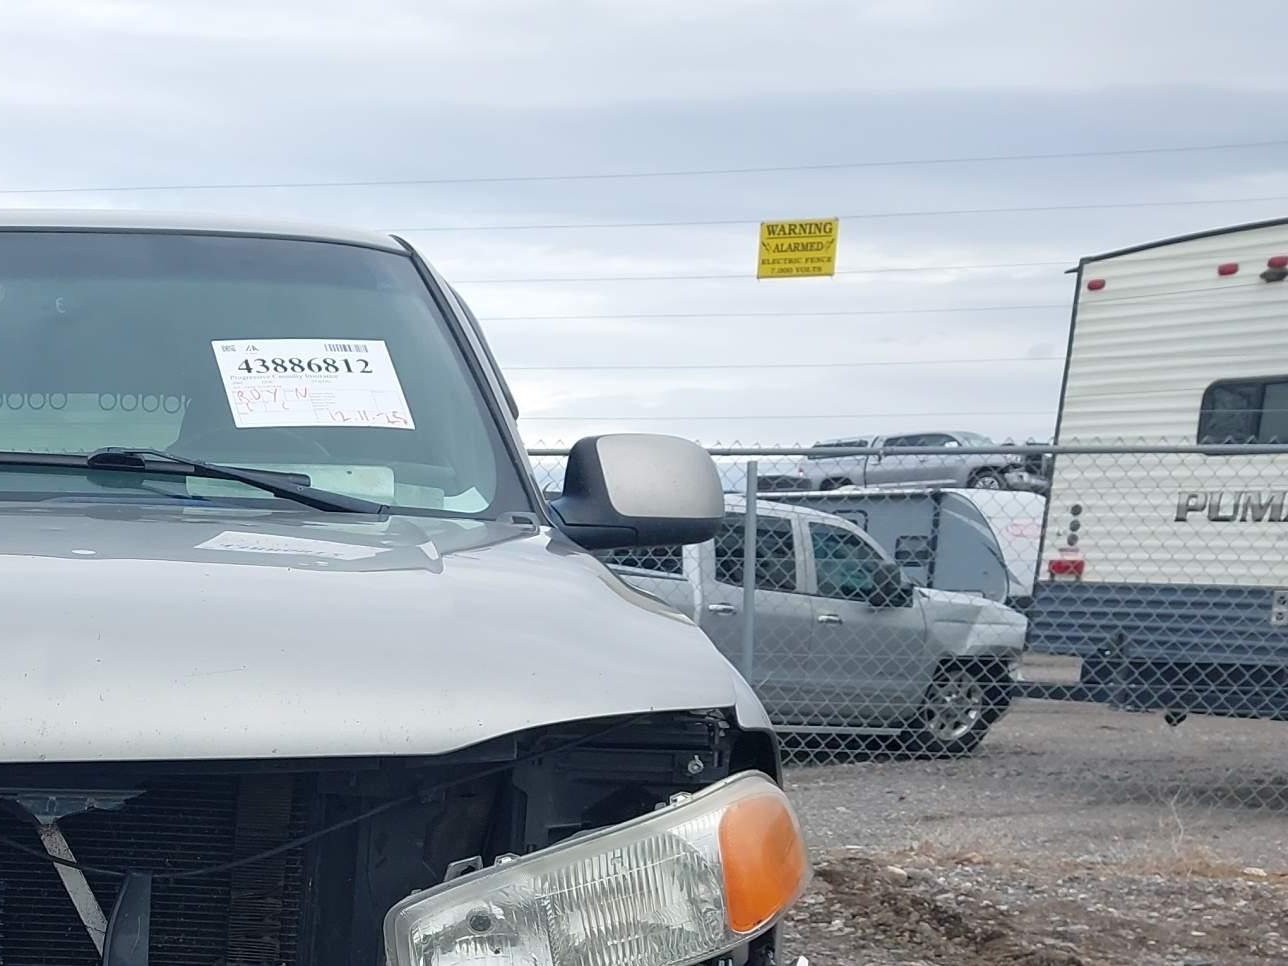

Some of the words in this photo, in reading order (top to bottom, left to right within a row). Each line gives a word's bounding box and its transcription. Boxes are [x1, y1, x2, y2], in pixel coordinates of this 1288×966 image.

[766, 222, 833, 236] WARNING
[772, 241, 824, 253] ALARMED
[237, 356, 374, 374] 43886812
[1174, 490, 1288, 522] PUM
